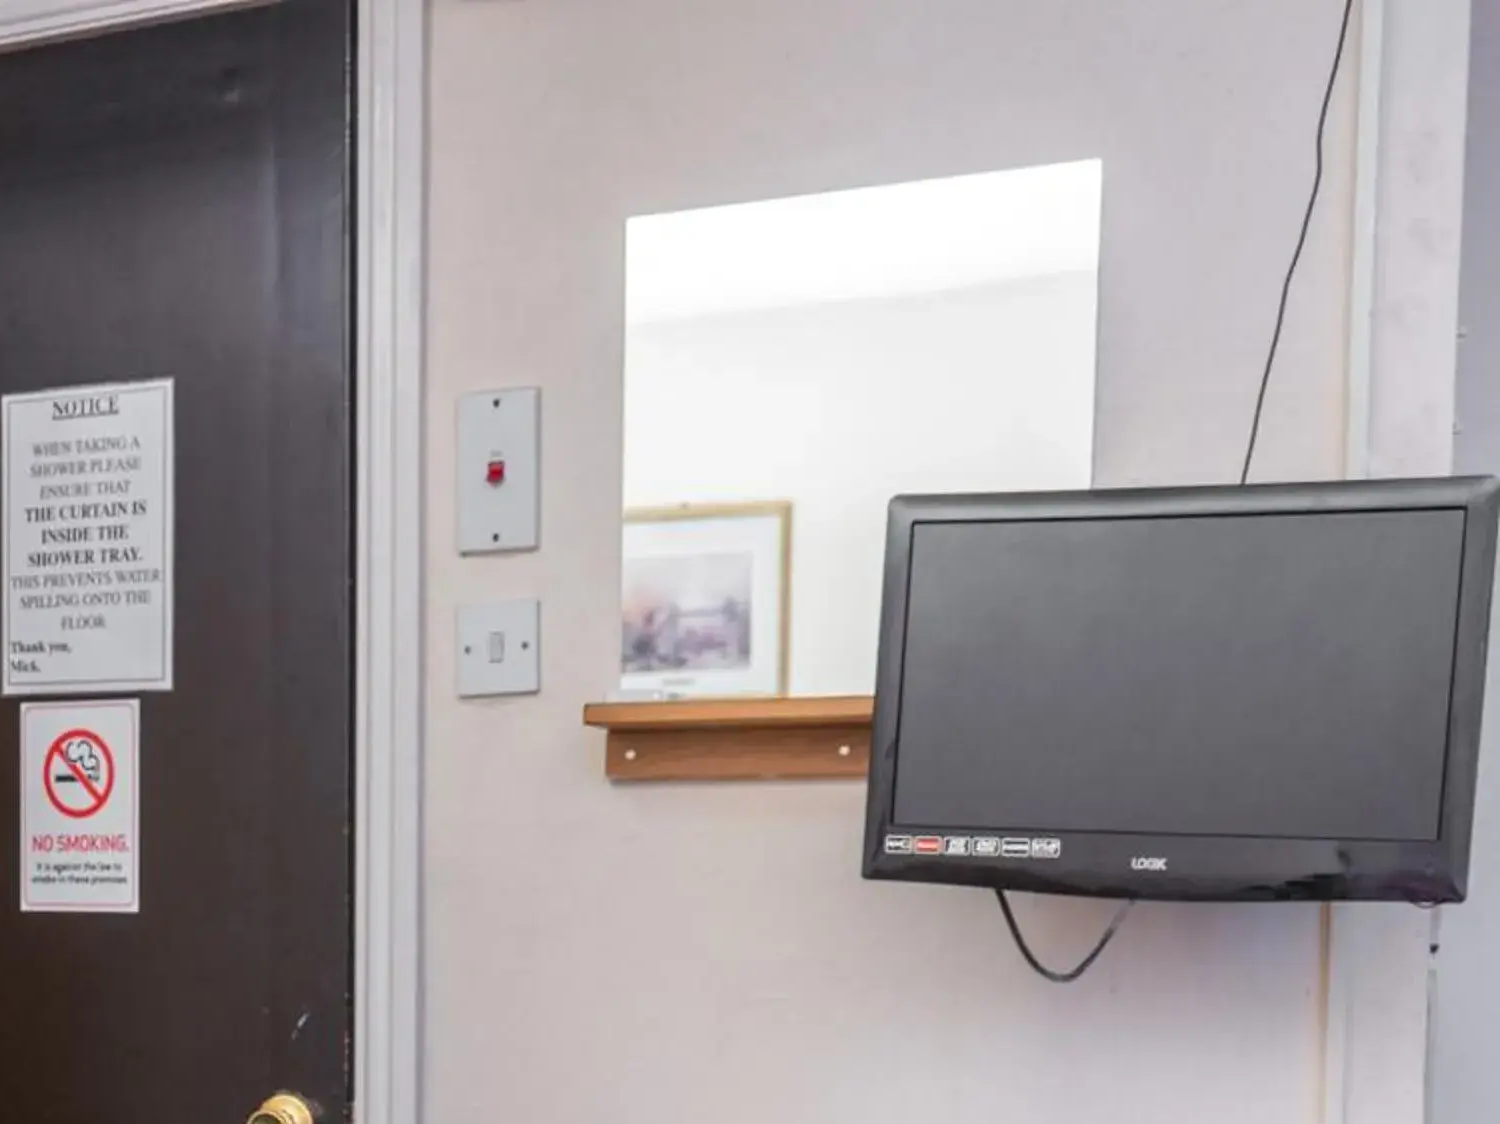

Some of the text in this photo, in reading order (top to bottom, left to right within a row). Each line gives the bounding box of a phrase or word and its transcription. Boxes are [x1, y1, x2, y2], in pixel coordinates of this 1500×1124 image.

[52, 396, 119, 419] NOTICE
[32, 435, 140, 457] WHEN TAKING A
[29, 457, 141, 478] SHOWER PLEASE
[40, 480, 131, 500] ENSURE THAT
[25, 500, 147, 523] THE CURTAIN IS
[41, 524, 129, 545] INSIDE THE
[28, 547, 143, 567] SHOWER TRAY.
[10, 568, 163, 590] THIS PREVENTS WATER
[20, 590, 151, 609] SPILLING ONTO THE
[10, 641, 45, 654] Thank
[32, 834, 53, 853] NO
